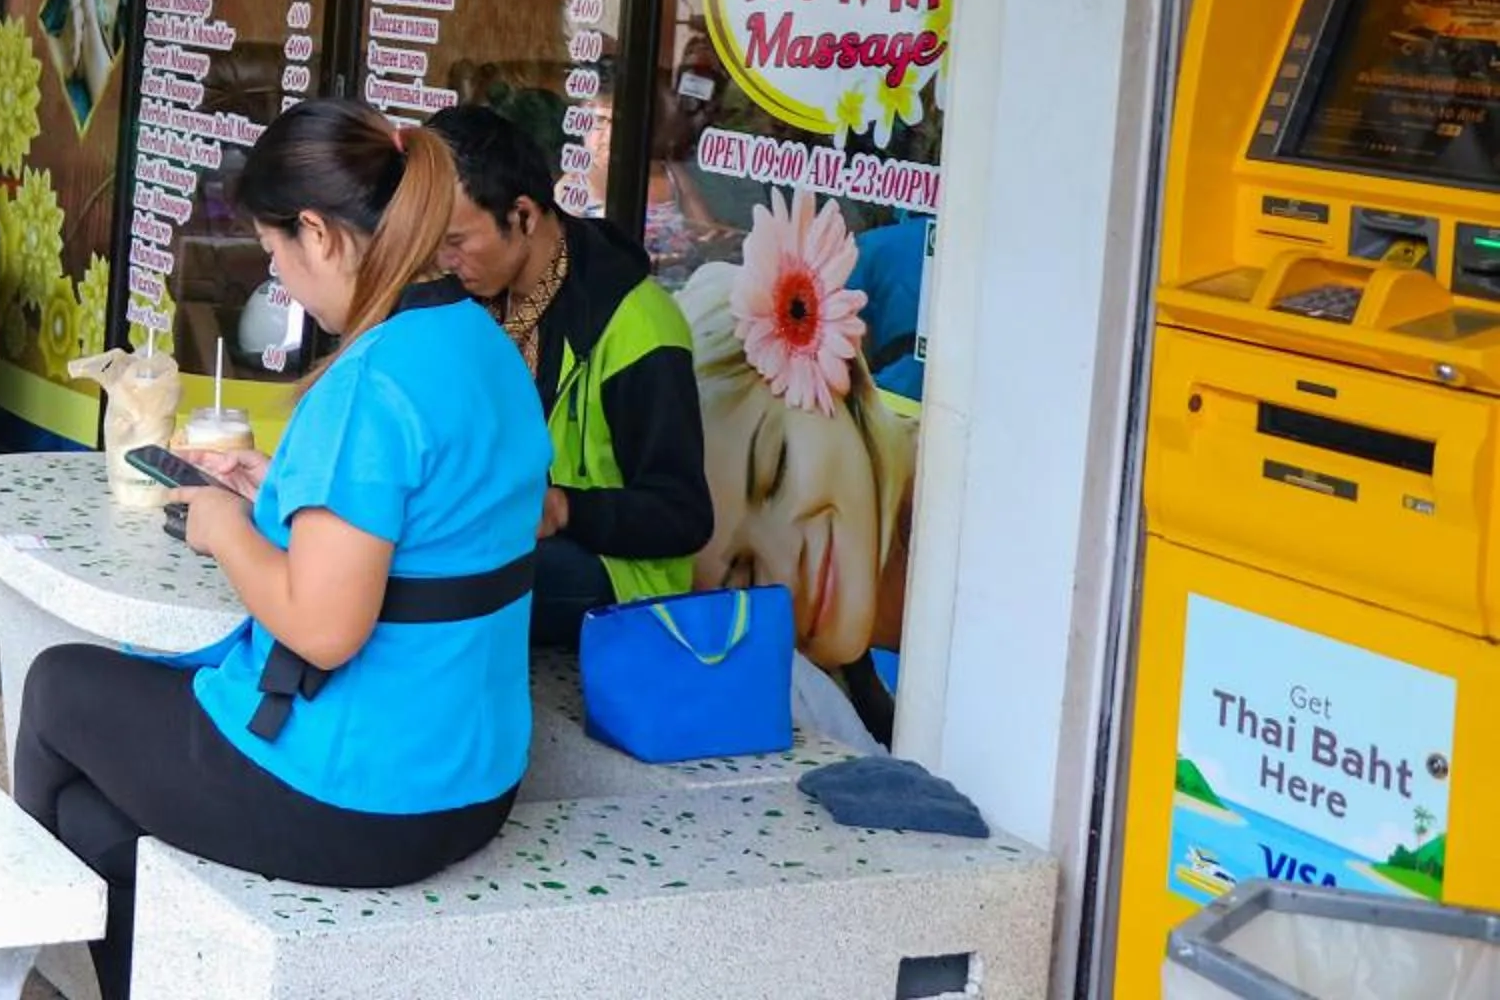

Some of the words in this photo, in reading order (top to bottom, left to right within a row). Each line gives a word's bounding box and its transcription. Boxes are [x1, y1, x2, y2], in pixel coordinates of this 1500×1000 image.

[286, 38, 311, 59] 400
[571, 35, 601, 58] 400
[744, 10, 947, 88] Massage
[283, 69, 309, 90] 500
[567, 74, 596, 95] 400
[565, 111, 593, 132] 500
[563, 149, 591, 169] 700
[701, 133, 747, 169] OPEN
[752, 142, 802, 180] 09:00
[561, 184, 589, 206] 700
[1289, 685, 1332, 721] Get
[1212, 688, 1296, 753] Thai
[1311, 726, 1414, 799] Baht
[1258, 755, 1348, 819] Here
